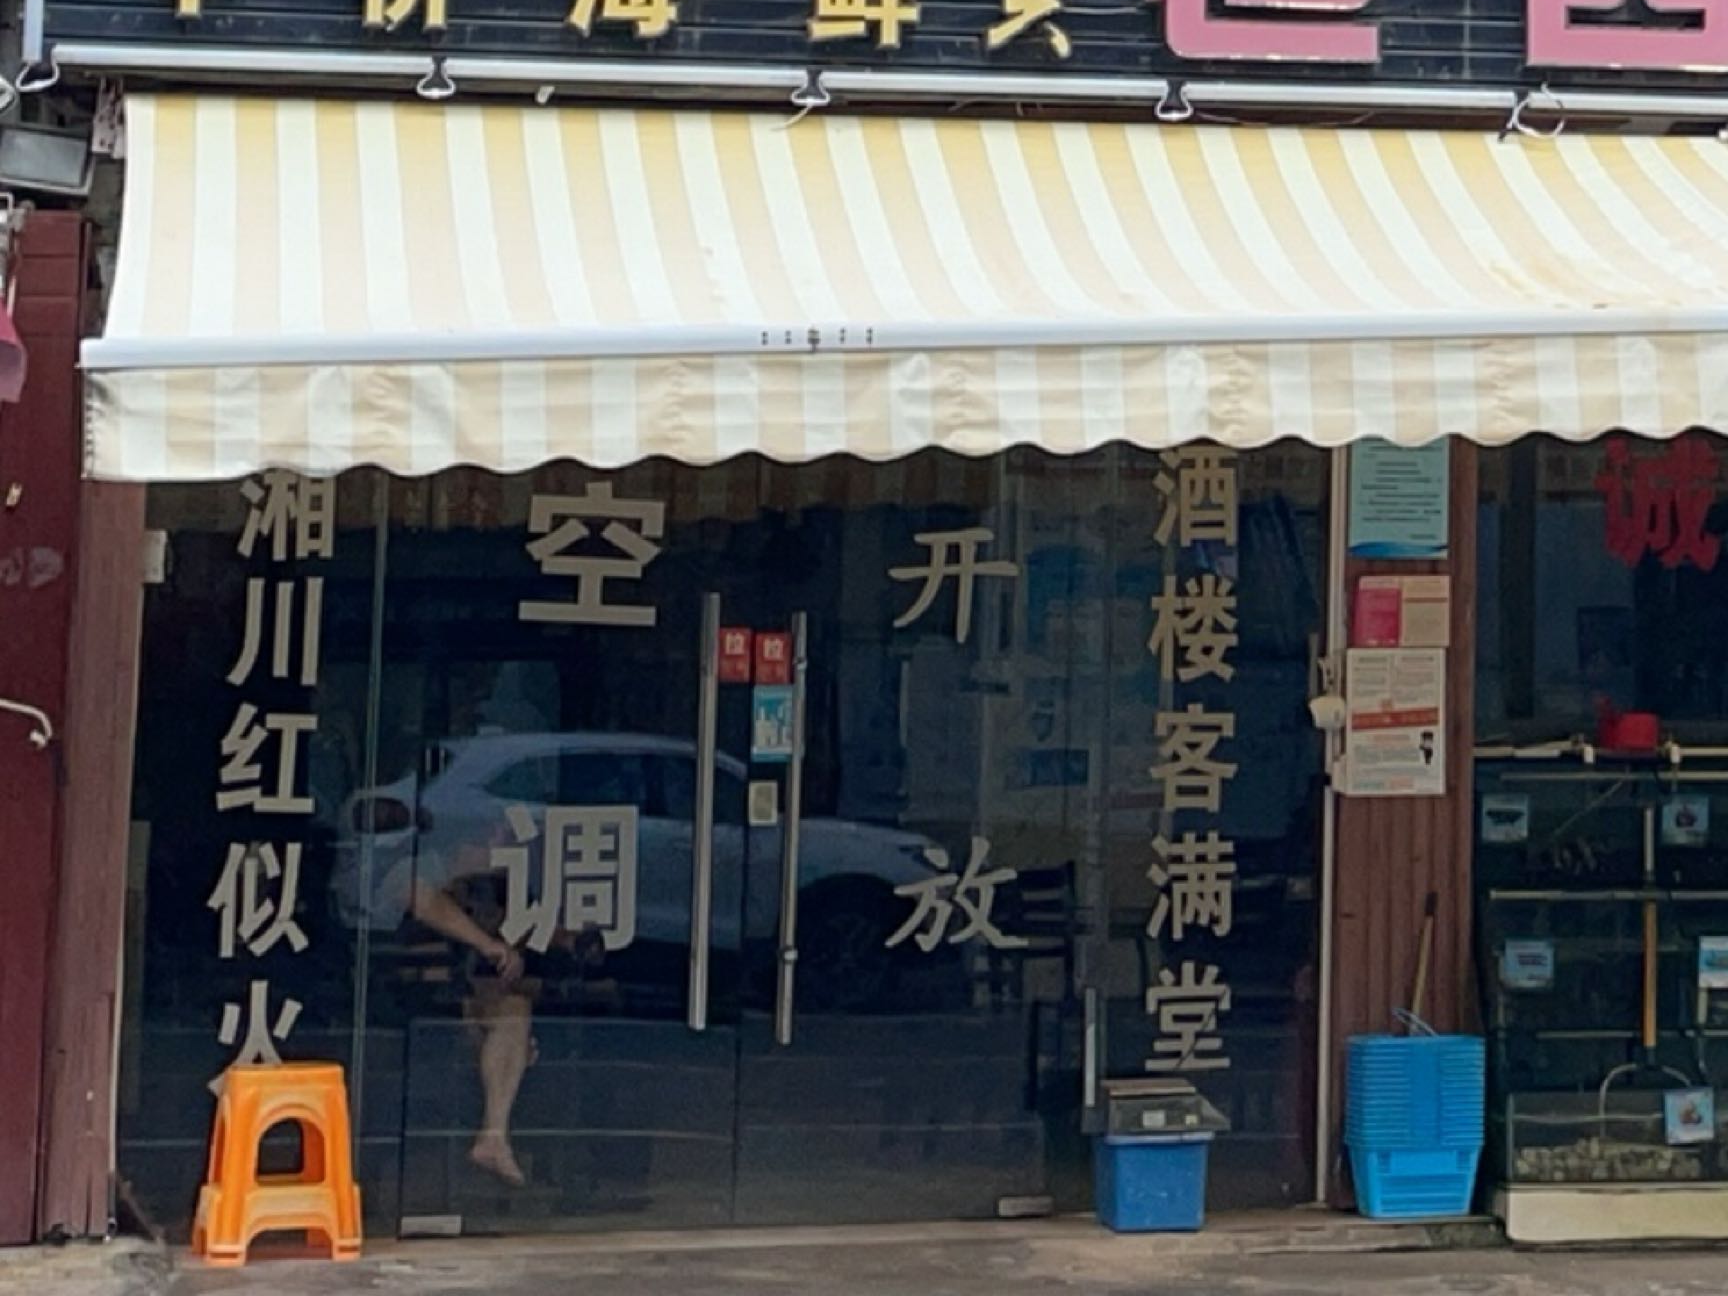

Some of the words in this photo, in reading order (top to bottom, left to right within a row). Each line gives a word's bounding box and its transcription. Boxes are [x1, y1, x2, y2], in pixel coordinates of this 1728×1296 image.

[490, 481, 666, 953] 空调
[885, 527, 1030, 953] 开放
[1144, 442, 1240, 1073] 酒楼客满堂
